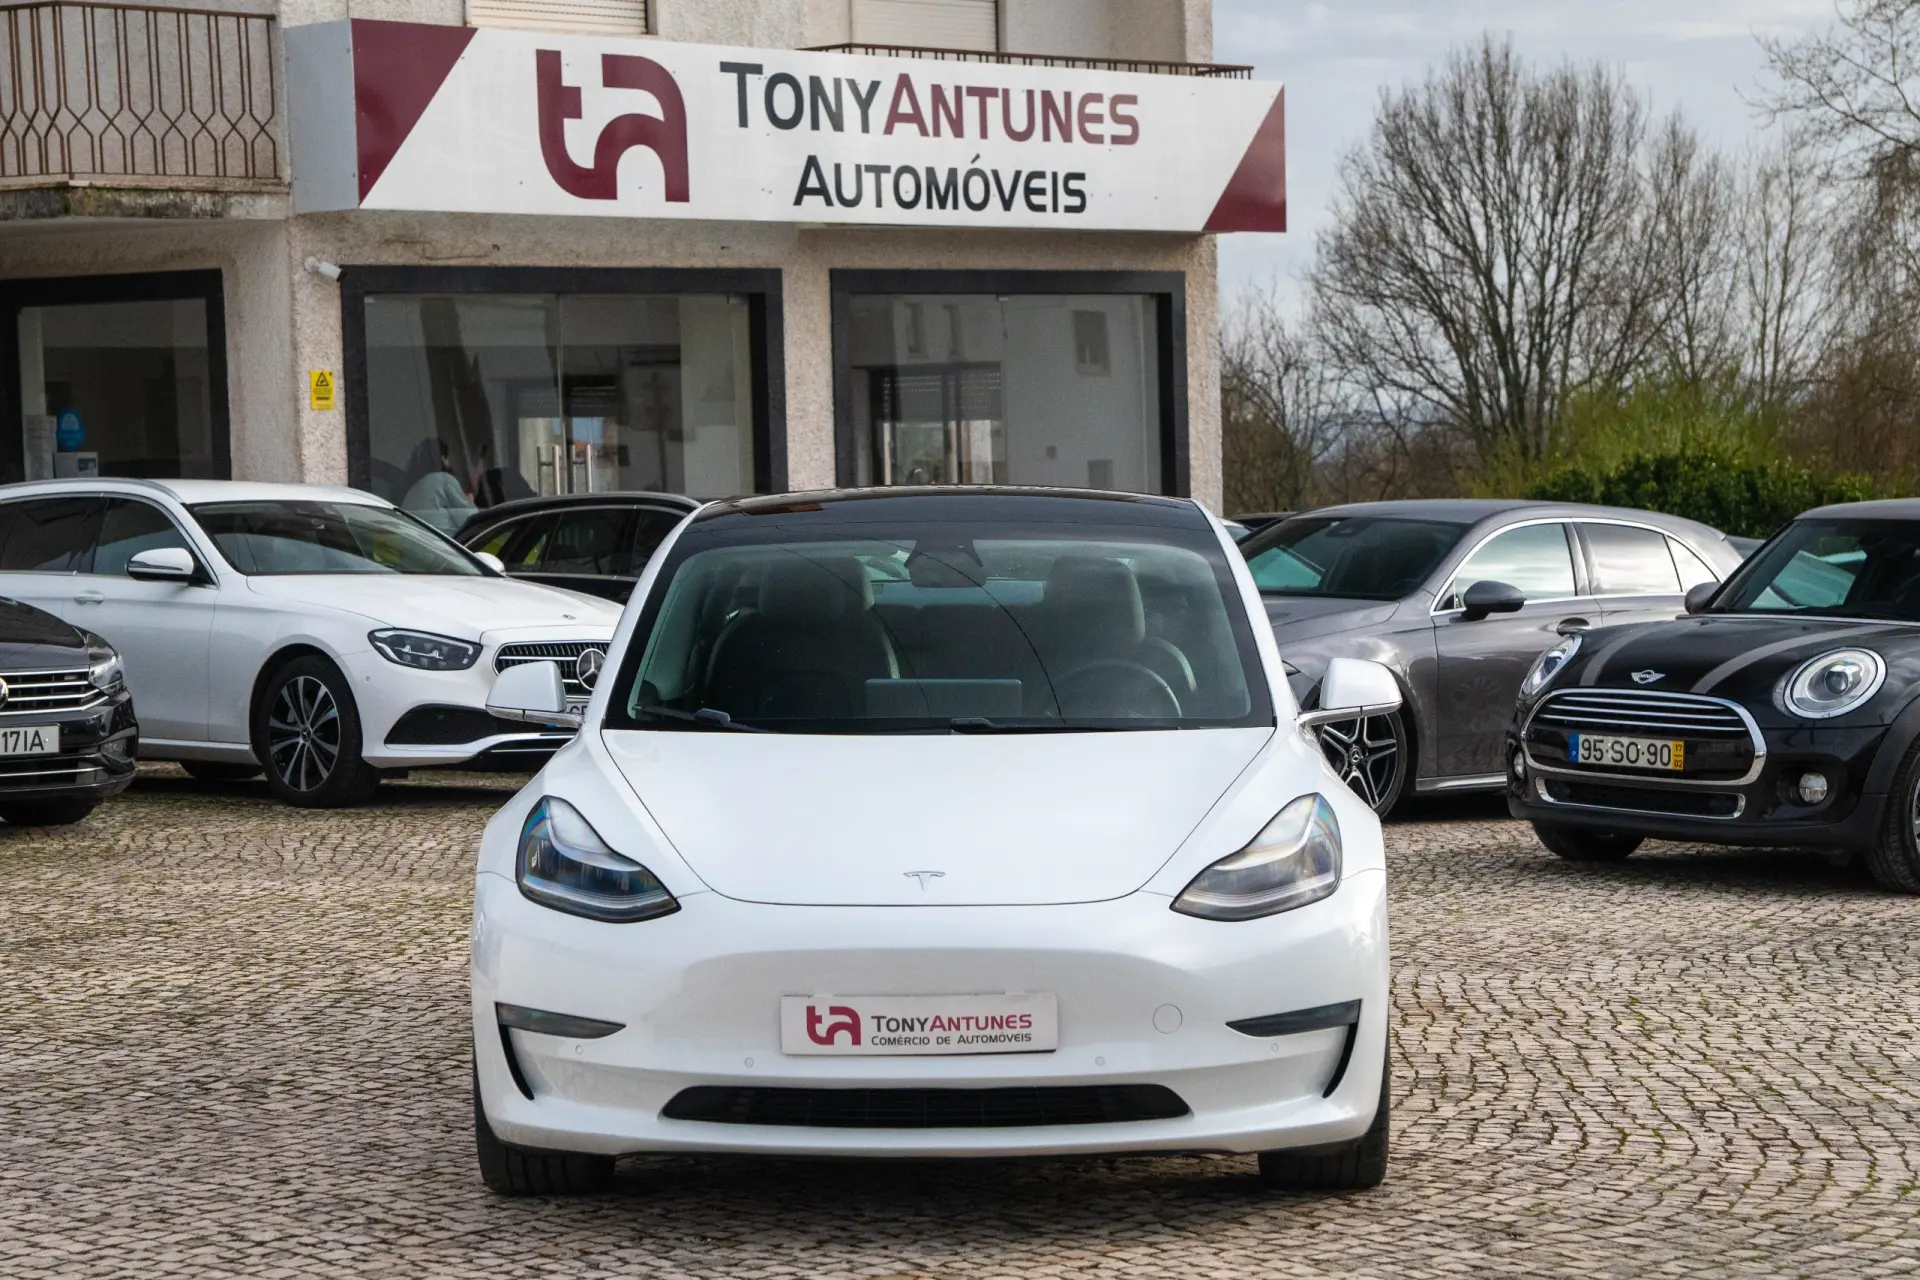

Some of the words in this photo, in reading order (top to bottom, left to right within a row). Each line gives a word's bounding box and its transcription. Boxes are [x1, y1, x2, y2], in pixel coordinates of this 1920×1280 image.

[793, 153, 1087, 214] AUTOMÓVEIS
[871, 1034, 930, 1046] COMÉRCIO
[936, 1036, 951, 1045] DE
[957, 1032, 1032, 1044] AUTOMÓVEIS
